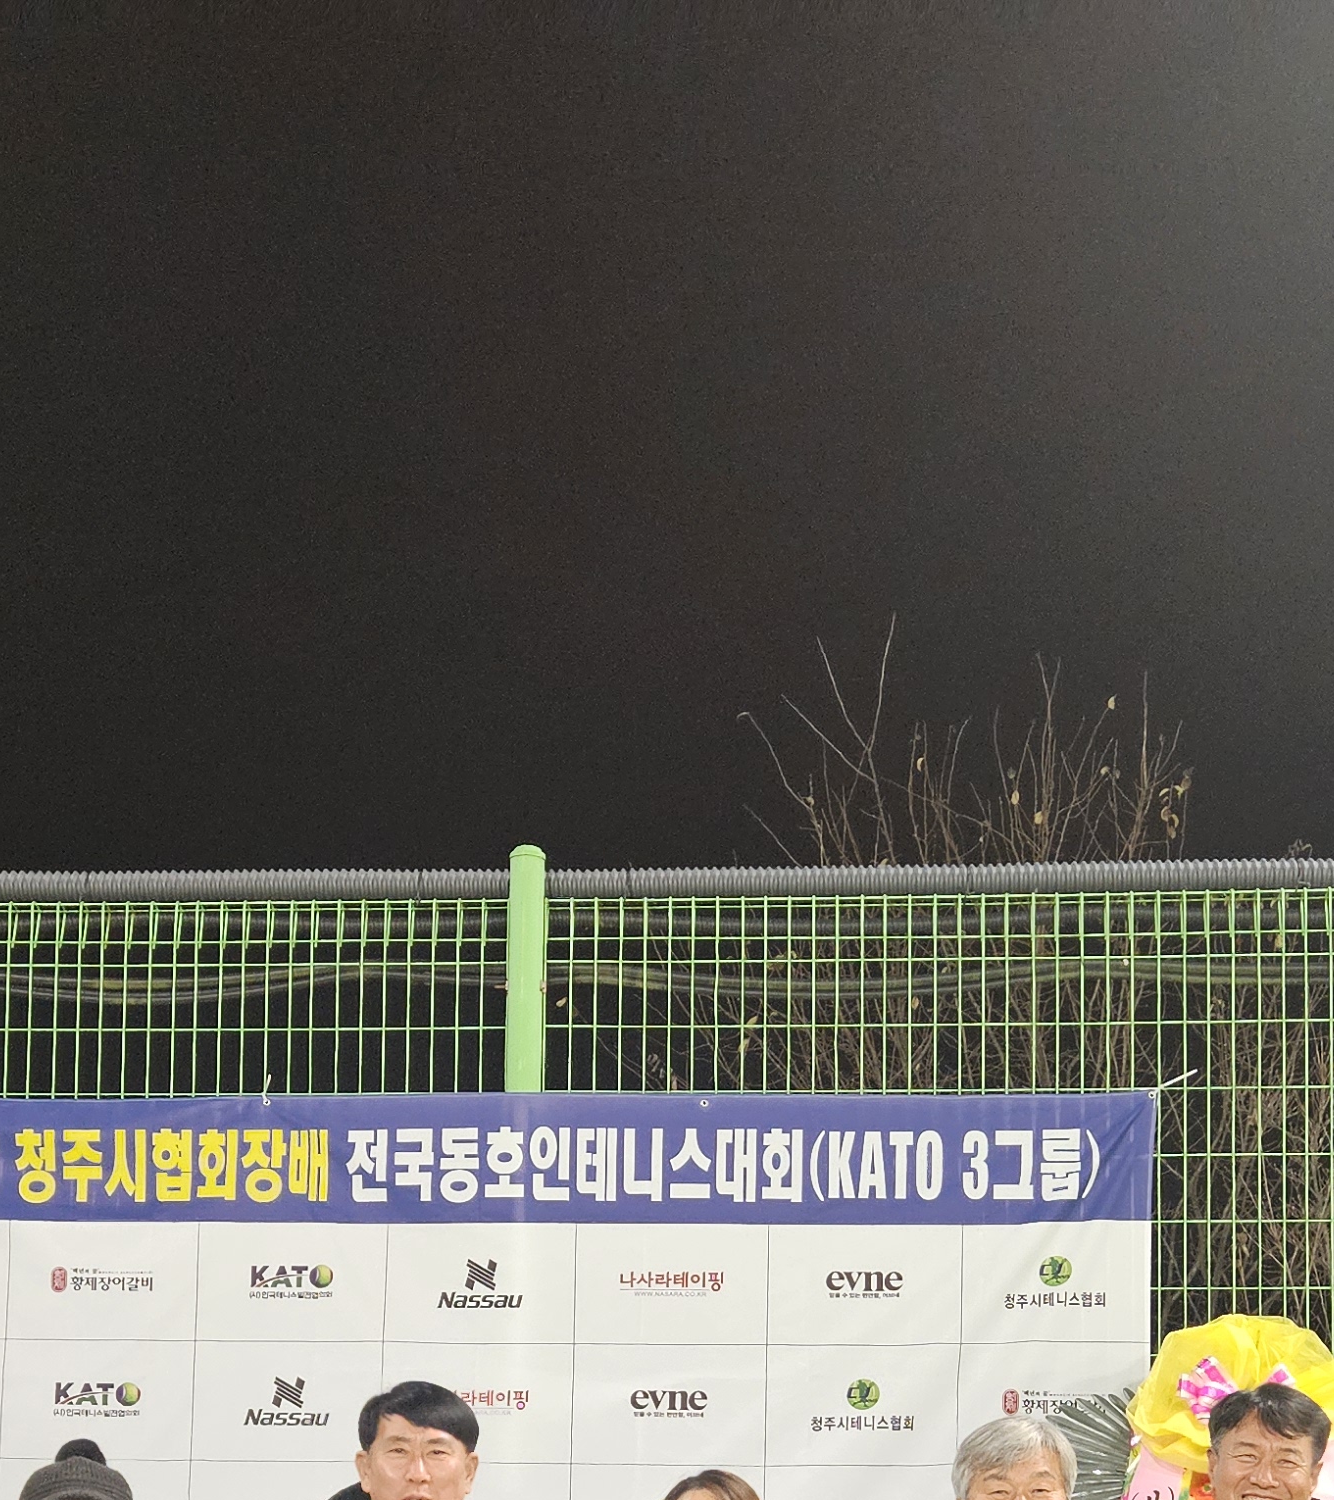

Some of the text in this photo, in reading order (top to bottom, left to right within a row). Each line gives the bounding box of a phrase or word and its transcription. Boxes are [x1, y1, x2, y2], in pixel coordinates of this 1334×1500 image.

[14, 1128, 329, 1203] 청주시협회장배
[346, 1126, 944, 1202] 전국동호인테니스대회(KATO
[962, 1127, 1101, 1201] 3그룹)
[70, 1276, 154, 1292] 황제장어갈비
[250, 1264, 334, 1289] KATO
[619, 1271, 724, 1292] 나사라테이핑
[825, 1270, 904, 1291] evne
[437, 1291, 523, 1309] Nassau
[1004, 1292, 1106, 1309] 청주시테니스협회
[55, 1381, 141, 1406] KATO
[630, 1389, 708, 1411] evne
[243, 1409, 329, 1426] Nassau
[810, 1415, 915, 1432] 청주시테니스협회
